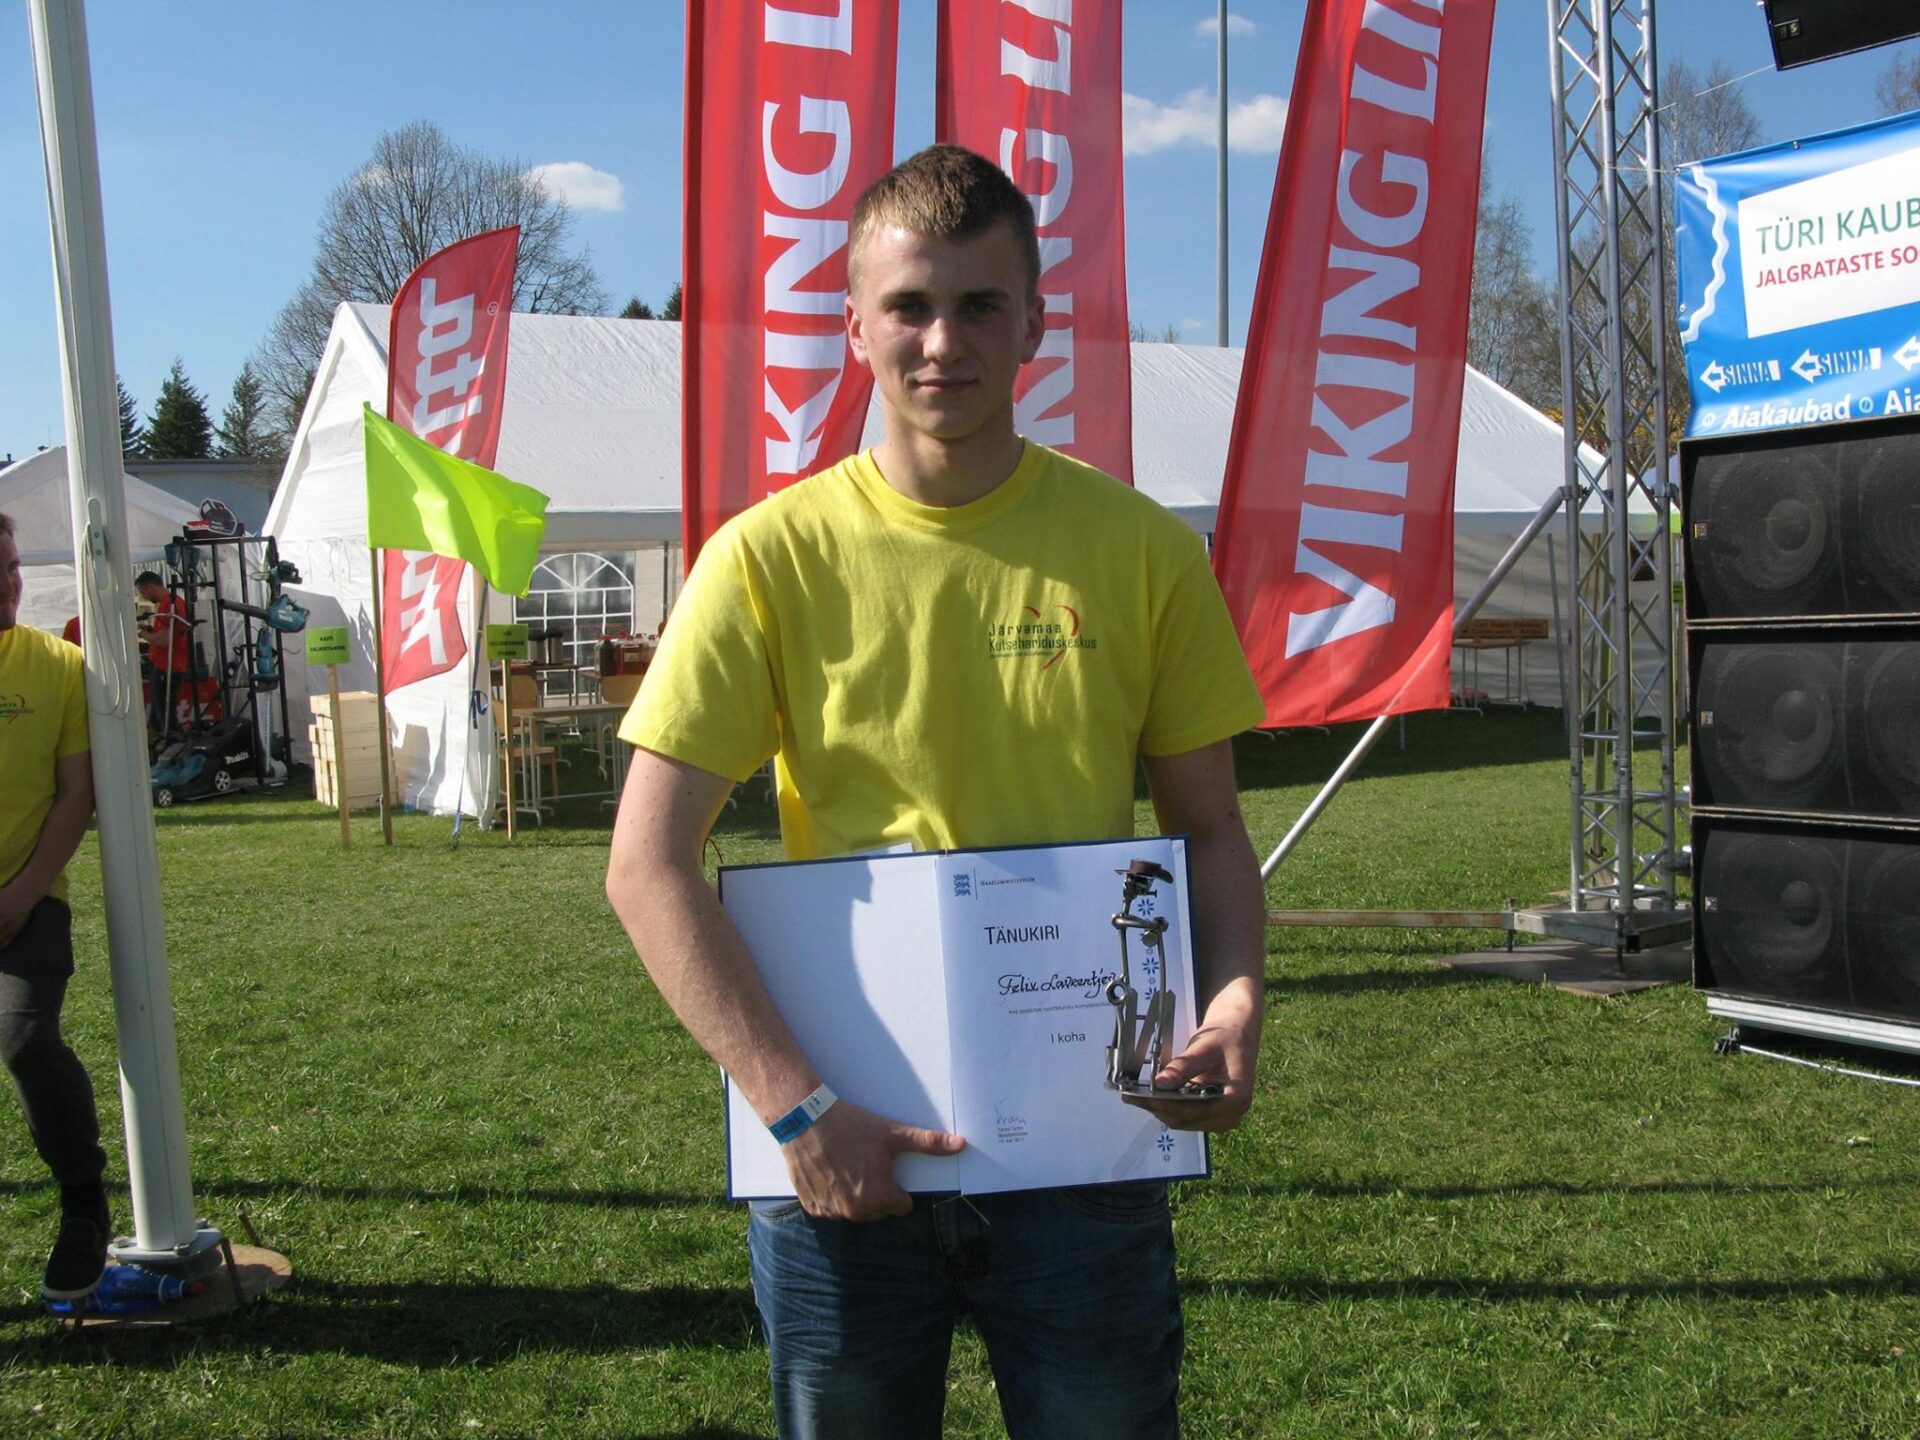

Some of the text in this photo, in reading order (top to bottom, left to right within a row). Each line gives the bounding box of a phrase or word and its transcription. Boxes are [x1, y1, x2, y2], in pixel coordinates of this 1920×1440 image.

[1756, 216, 1824, 255] TÜRI
[1756, 244, 1920, 288] JALGRATASTE SO
[762, 94, 852, 497] KING
[1285, 0, 1446, 659] VIKING LI
[1721, 393, 1852, 430] Aiakaubad
[984, 924, 1060, 945] TÄNUKIRI
[998, 974, 1039, 996] Felix
[1057, 1032, 1086, 1043] koha
